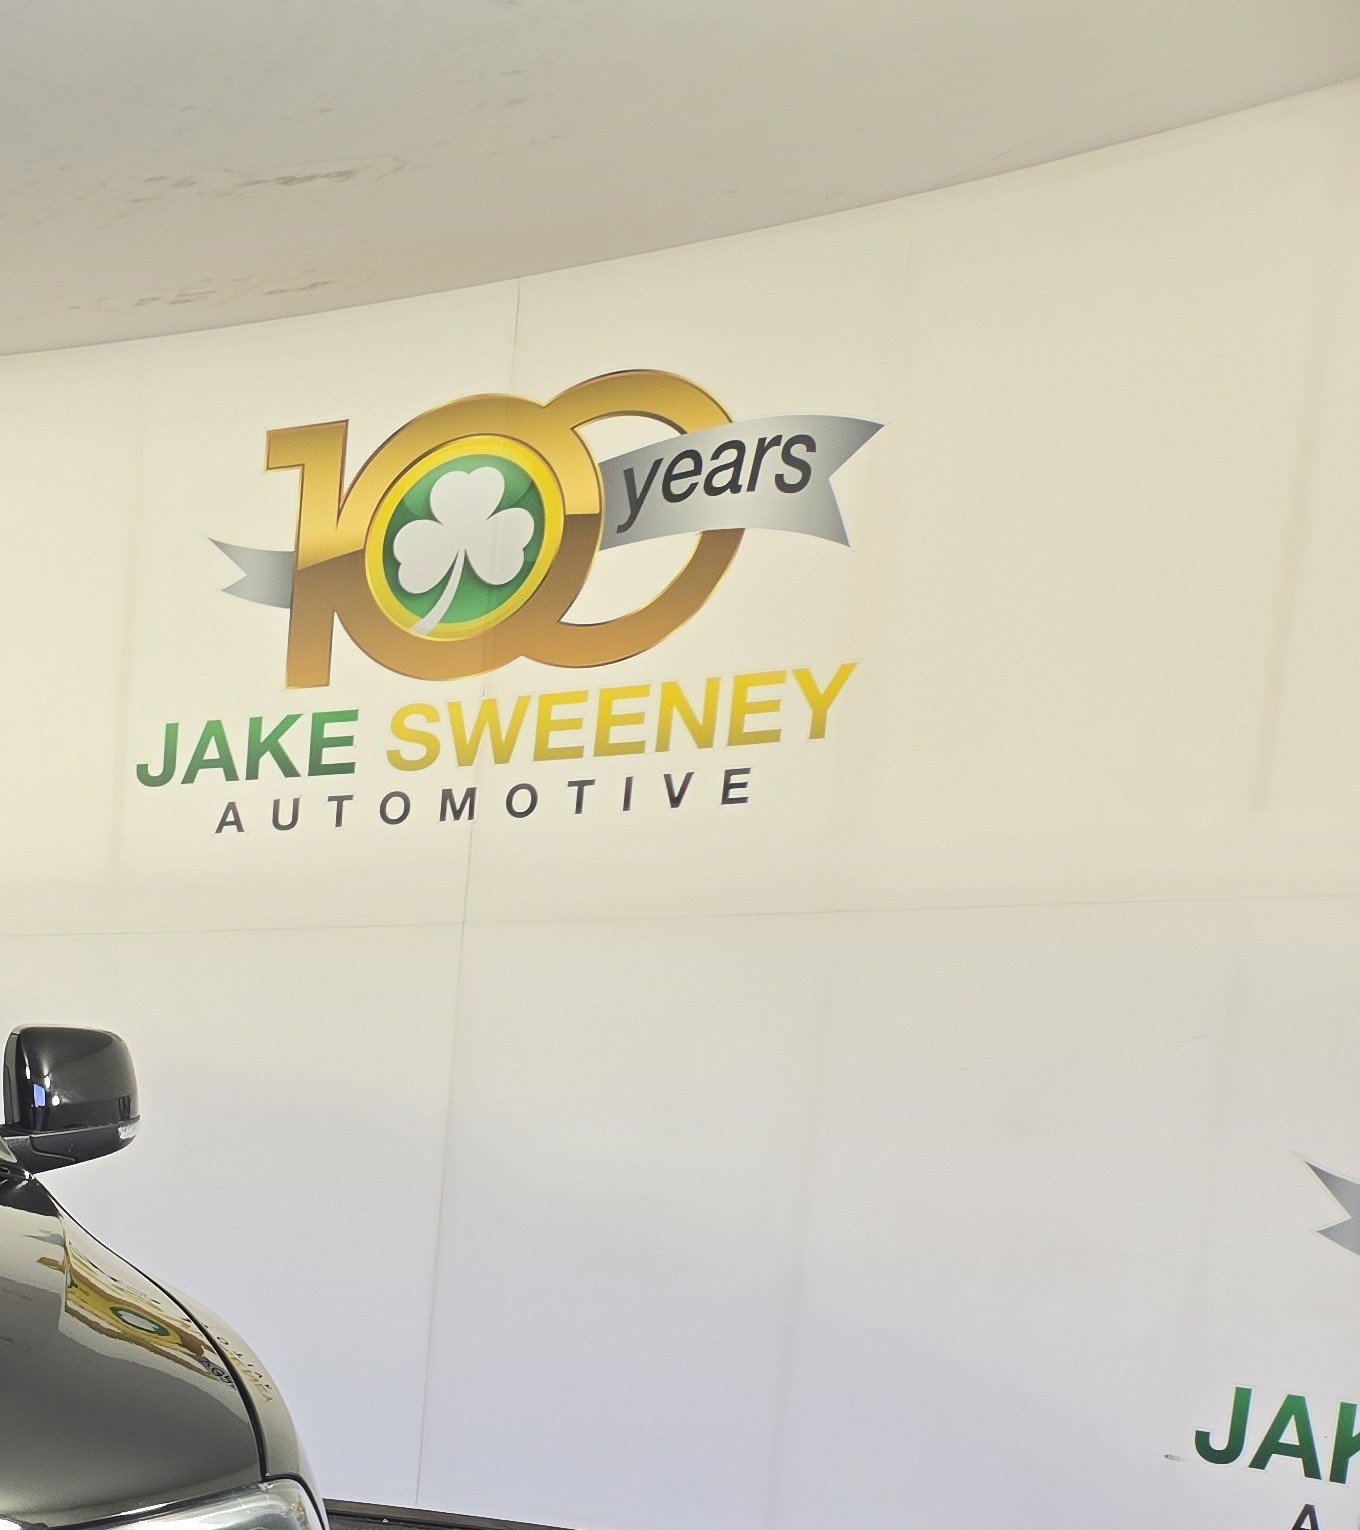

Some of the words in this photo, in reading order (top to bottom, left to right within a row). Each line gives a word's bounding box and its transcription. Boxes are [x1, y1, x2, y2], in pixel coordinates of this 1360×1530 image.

[264, 368, 747, 690] 100
[616, 433, 817, 534] years
[136, 708, 359, 788] JAKE
[385, 661, 858, 773] SWEENEY
[215, 767, 752, 835] AUTOMOTIVE
